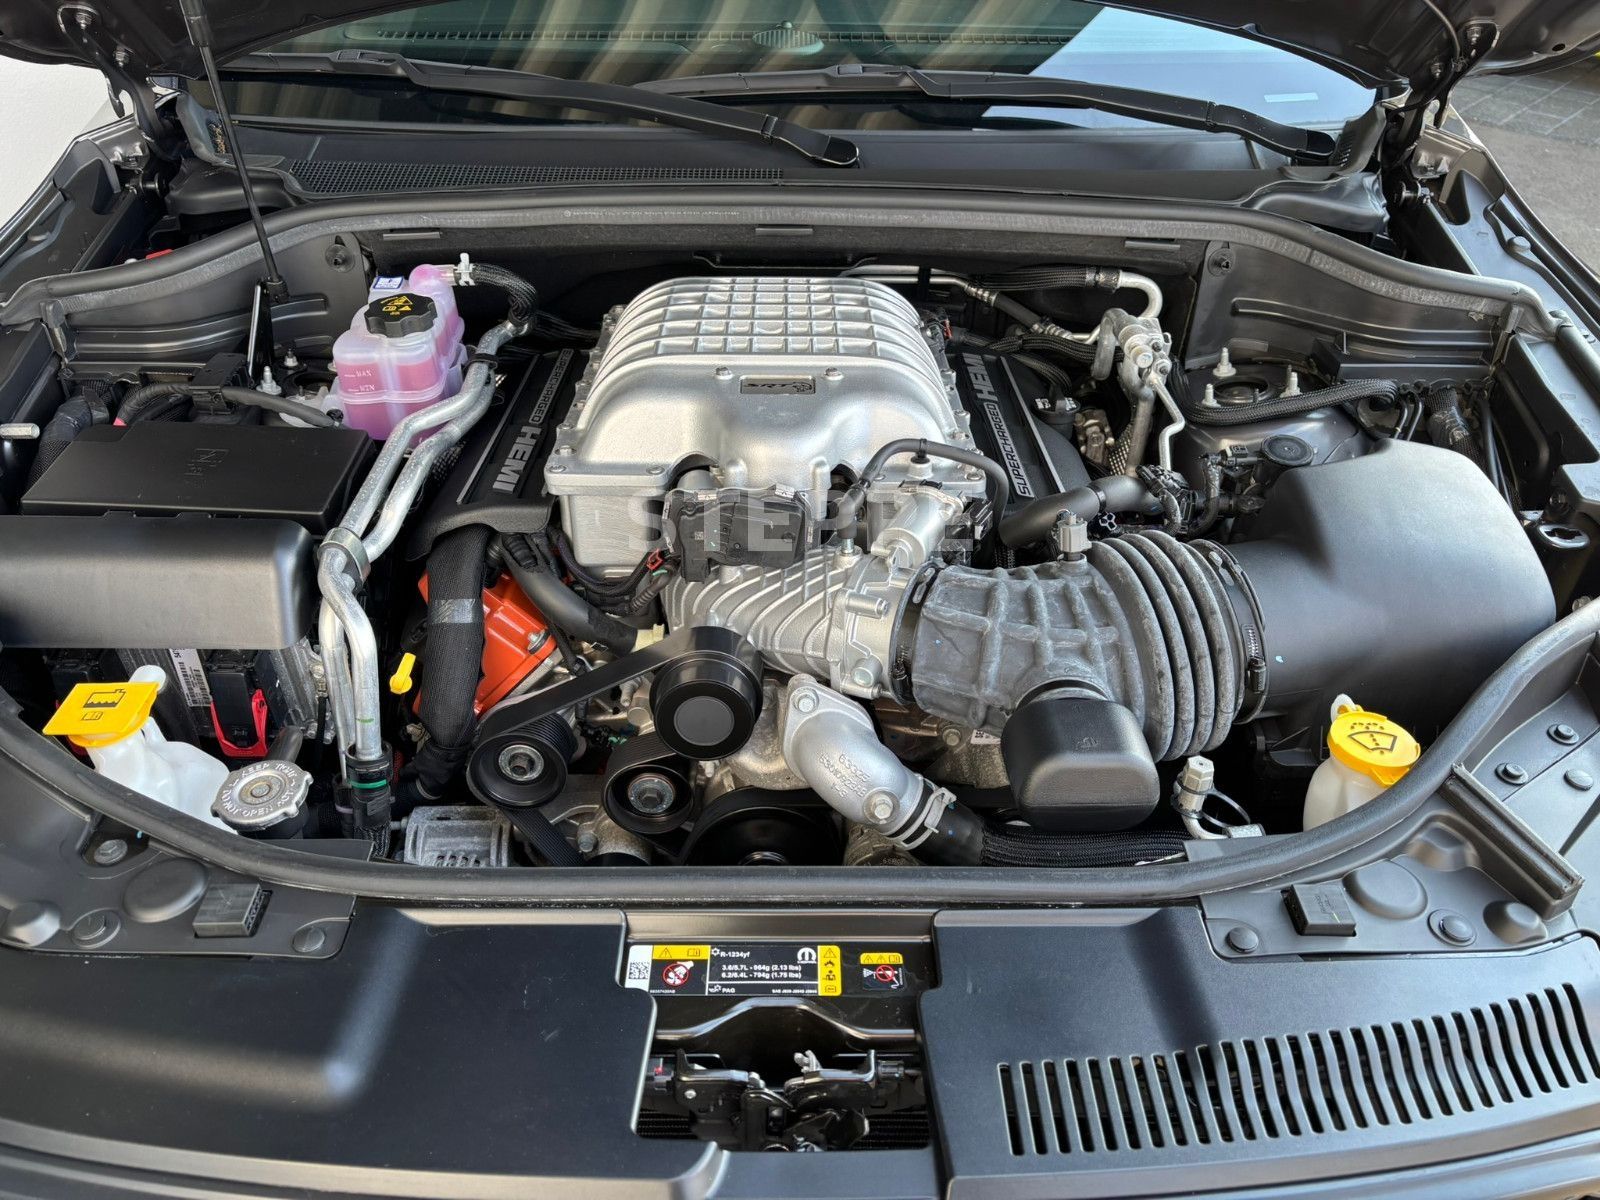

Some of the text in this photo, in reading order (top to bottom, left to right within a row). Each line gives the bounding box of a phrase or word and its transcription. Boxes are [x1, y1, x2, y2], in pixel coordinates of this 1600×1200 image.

[492, 350, 572, 494] SUPERCHARGED HEMI
[962, 352, 1032, 496] SUPERCHARGED HEMI
[242, 762, 270, 777] KEEP
[242, 805, 274, 817] OPEN
[720, 951, 750, 959] R-1234yf
